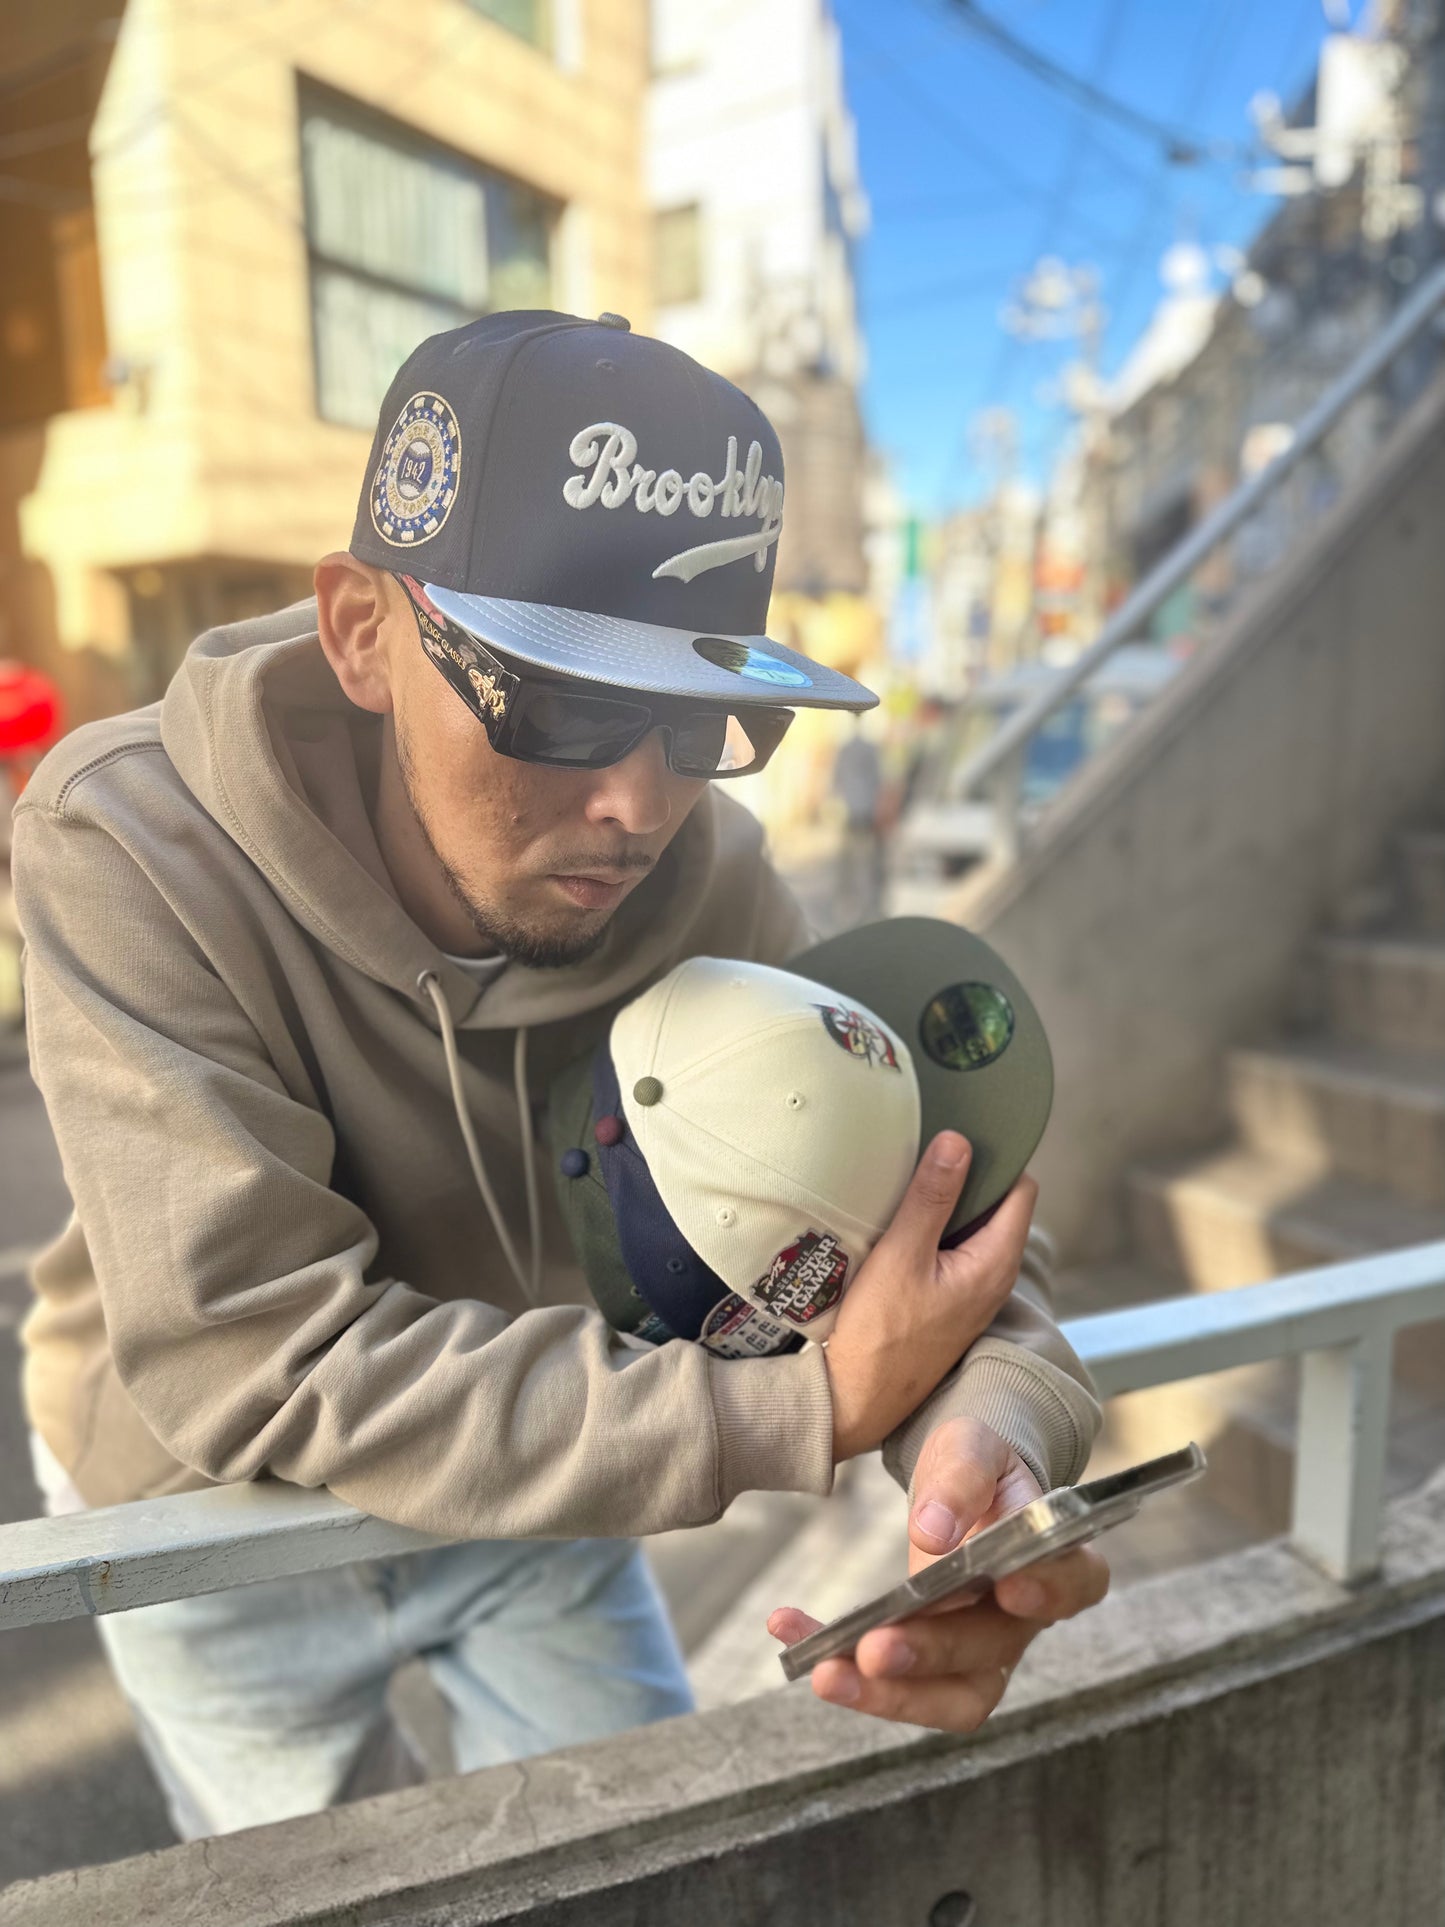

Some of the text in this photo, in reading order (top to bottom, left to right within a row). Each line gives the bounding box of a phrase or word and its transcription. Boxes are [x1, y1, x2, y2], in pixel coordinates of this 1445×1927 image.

[400, 456, 427, 485] 1942
[418, 611, 467, 671] GRUNGE GLASSES
[770, 1236, 837, 1317] ALL STAR
[776, 1250, 811, 1290] SEATTLE
[792, 1257, 837, 1309] GAME
